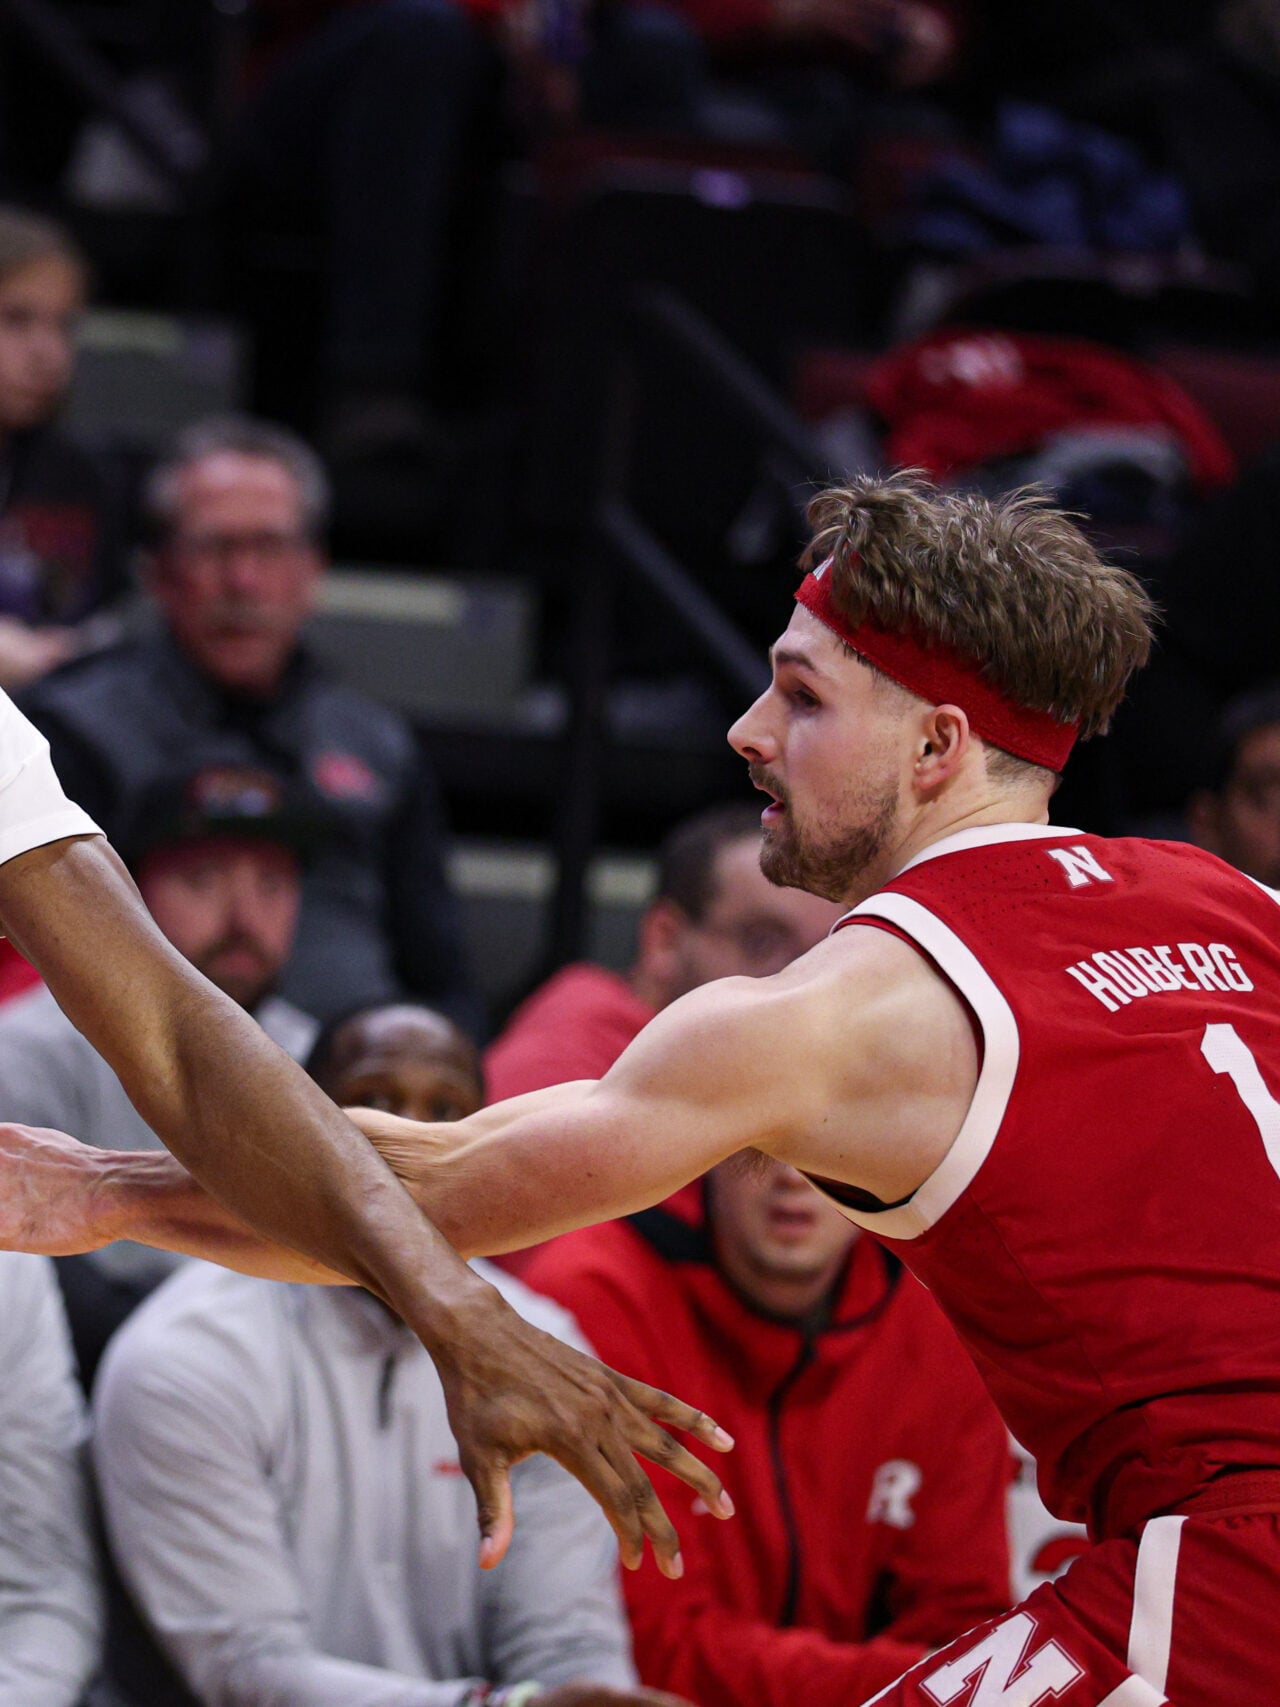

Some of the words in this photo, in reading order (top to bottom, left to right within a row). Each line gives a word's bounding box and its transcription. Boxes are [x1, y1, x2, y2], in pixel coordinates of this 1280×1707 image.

[1047, 845, 1115, 889] N
[1065, 943, 1255, 1013] HOIBERG
[1200, 1023, 1280, 1181] 1
[867, 1459, 922, 1530] R
[919, 1610, 1085, 1707] N
